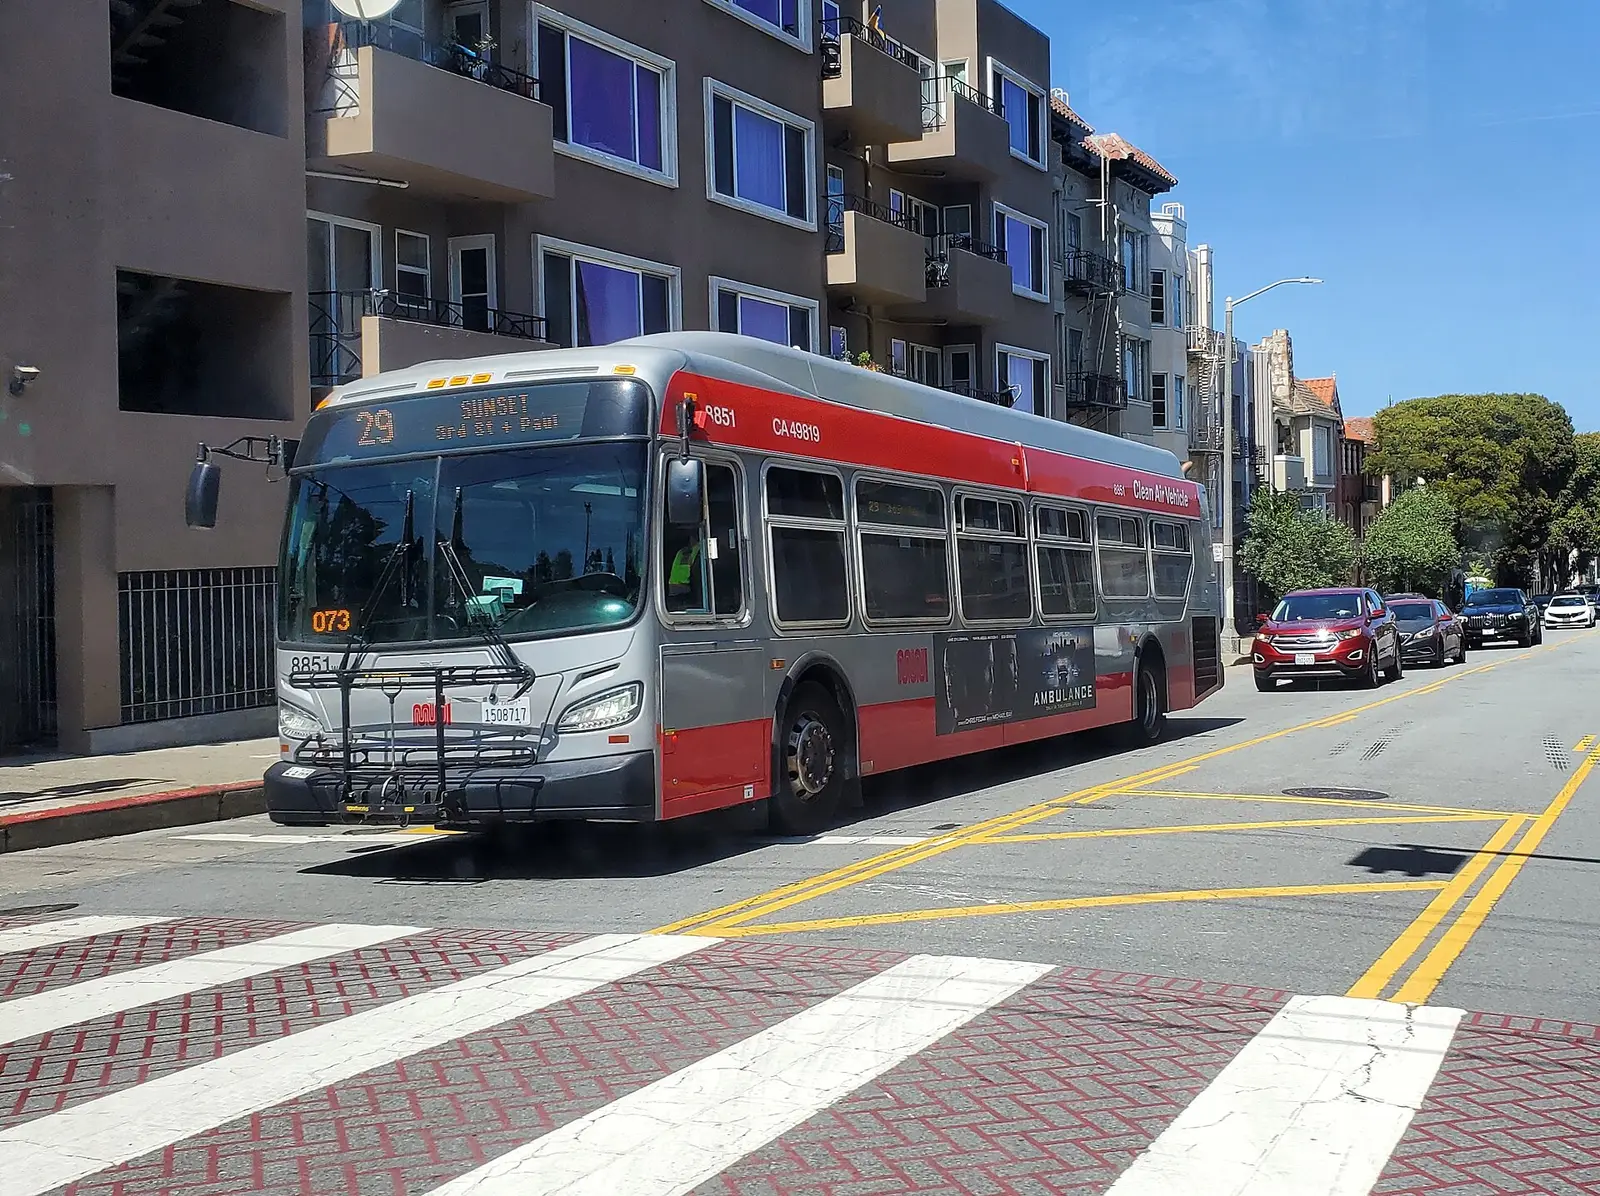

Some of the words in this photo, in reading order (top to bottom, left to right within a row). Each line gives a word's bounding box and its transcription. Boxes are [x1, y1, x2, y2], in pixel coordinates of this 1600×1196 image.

[461, 394, 528, 419] SUNSET
[705, 405, 736, 428] 8851
[356, 409, 395, 446] 29
[435, 423, 467, 440] 3rd
[474, 420, 494, 437] St
[1133, 479, 1154, 502] Clean
[1155, 484, 1165, 503] Air
[1165, 486, 1189, 508] Vehicle
[312, 609, 351, 632] 073
[291, 655, 330, 672] 8851
[1033, 684, 1094, 706] AMBULANCE
[484, 707, 528, 723] 1508717
